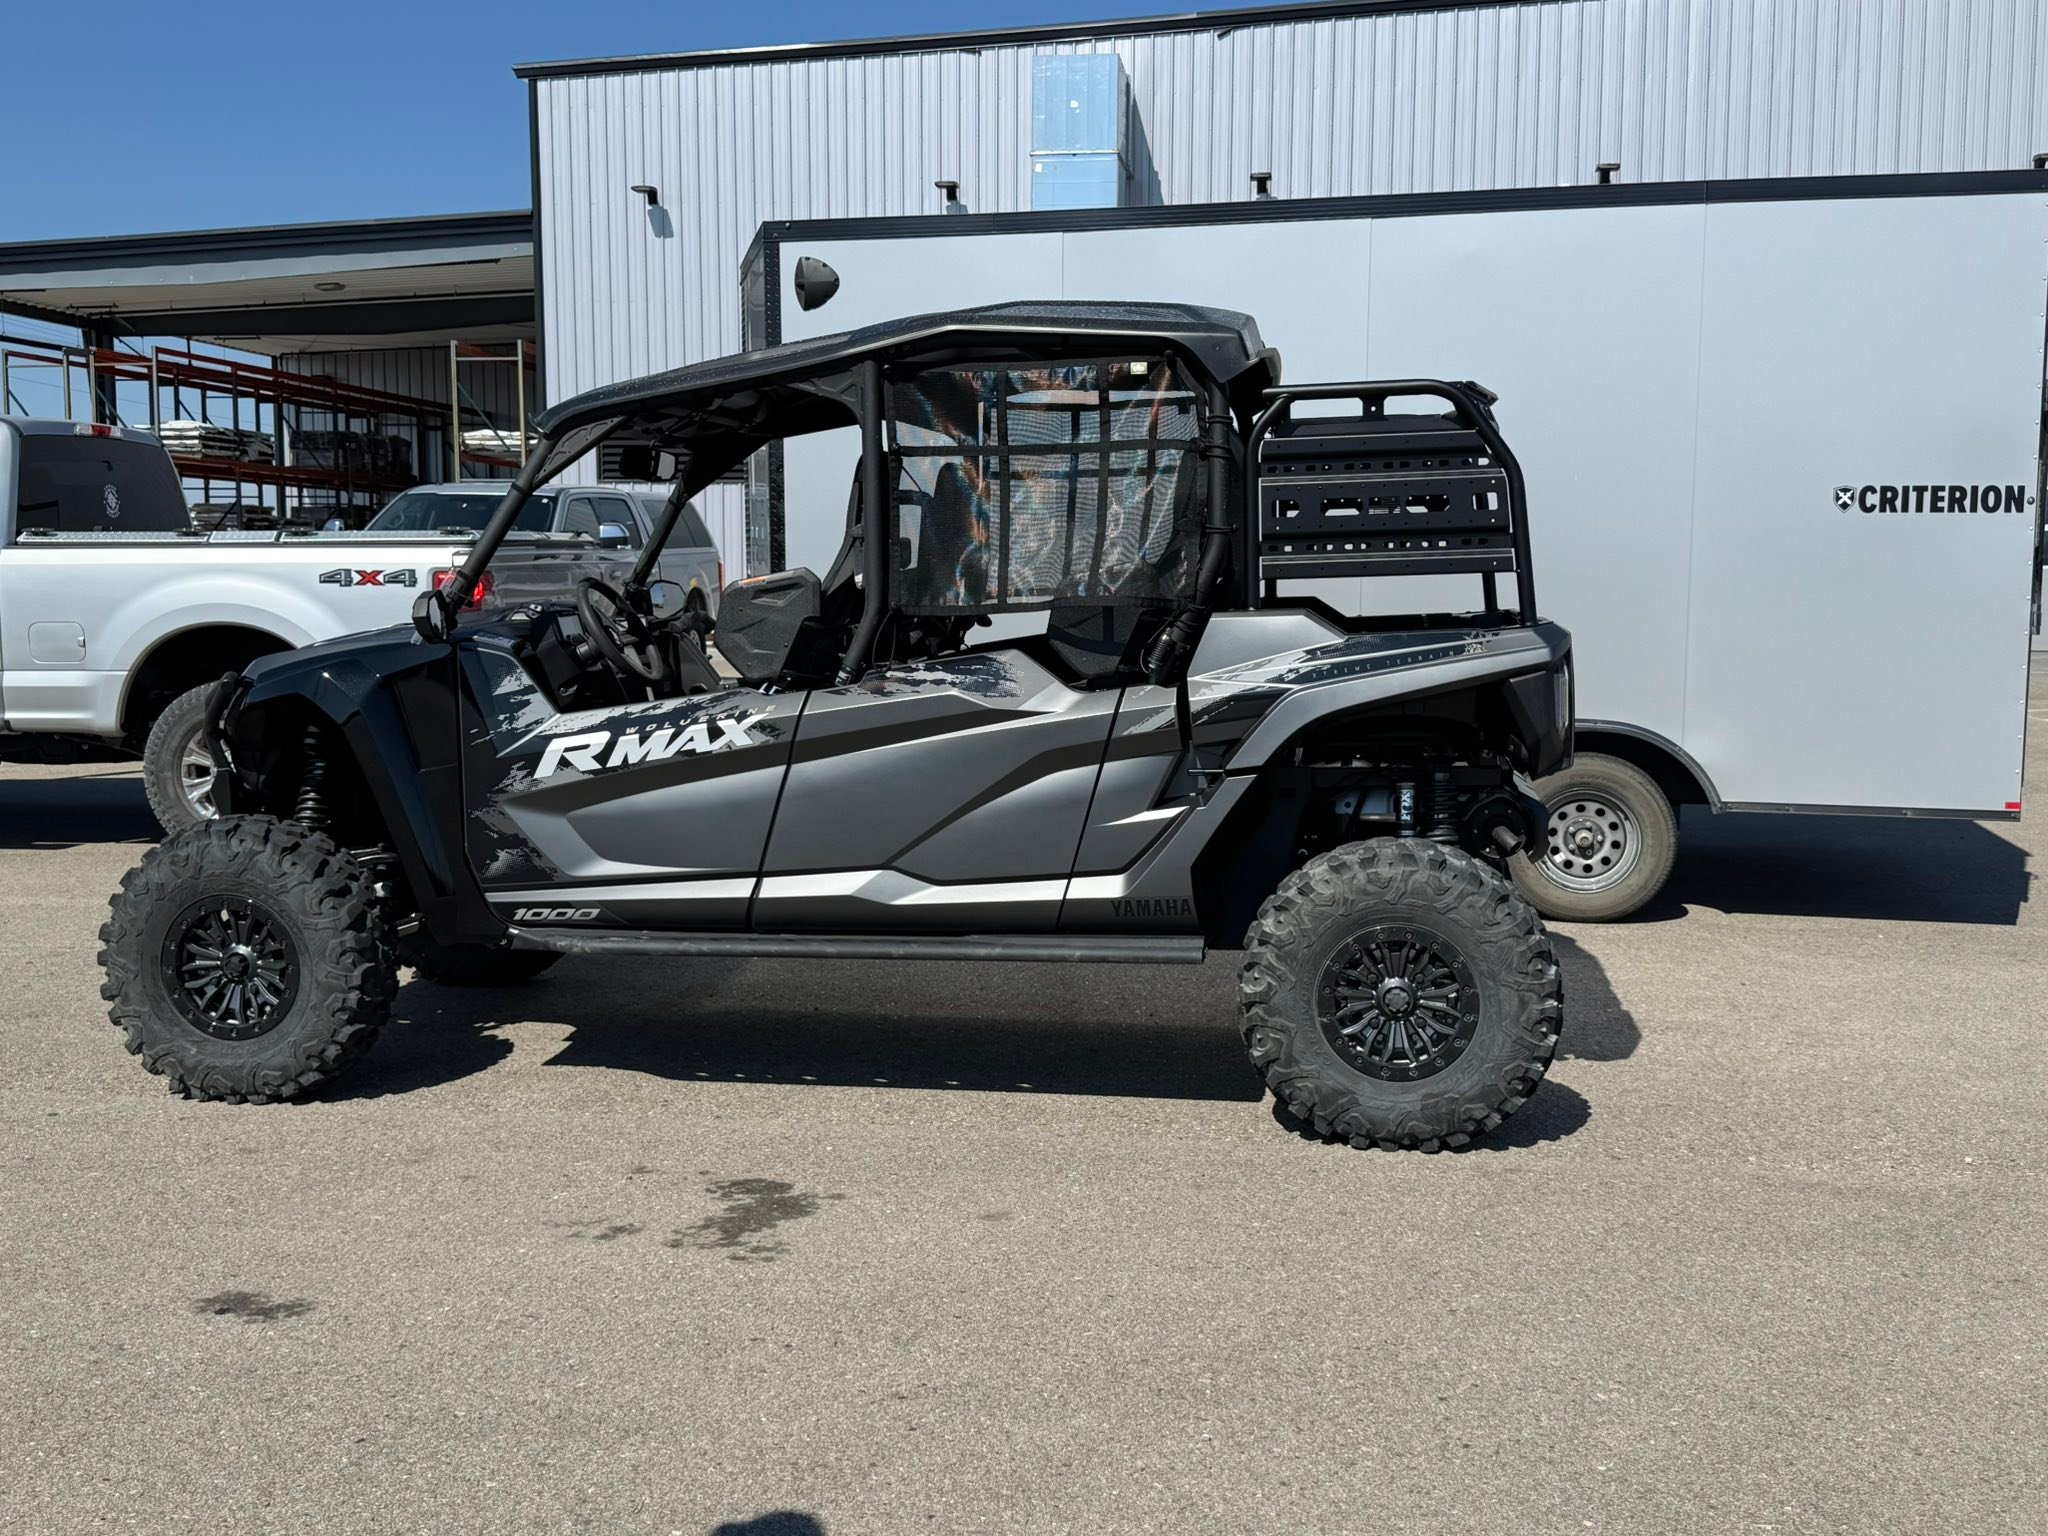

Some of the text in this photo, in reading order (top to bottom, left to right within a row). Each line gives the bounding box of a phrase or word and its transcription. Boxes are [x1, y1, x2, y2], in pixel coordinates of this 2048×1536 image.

[1858, 485, 2026, 513] CRITERION
[533, 712, 770, 779] RMAX
[512, 908, 601, 921] 1000
[1111, 898, 1193, 917] YAMAHA
